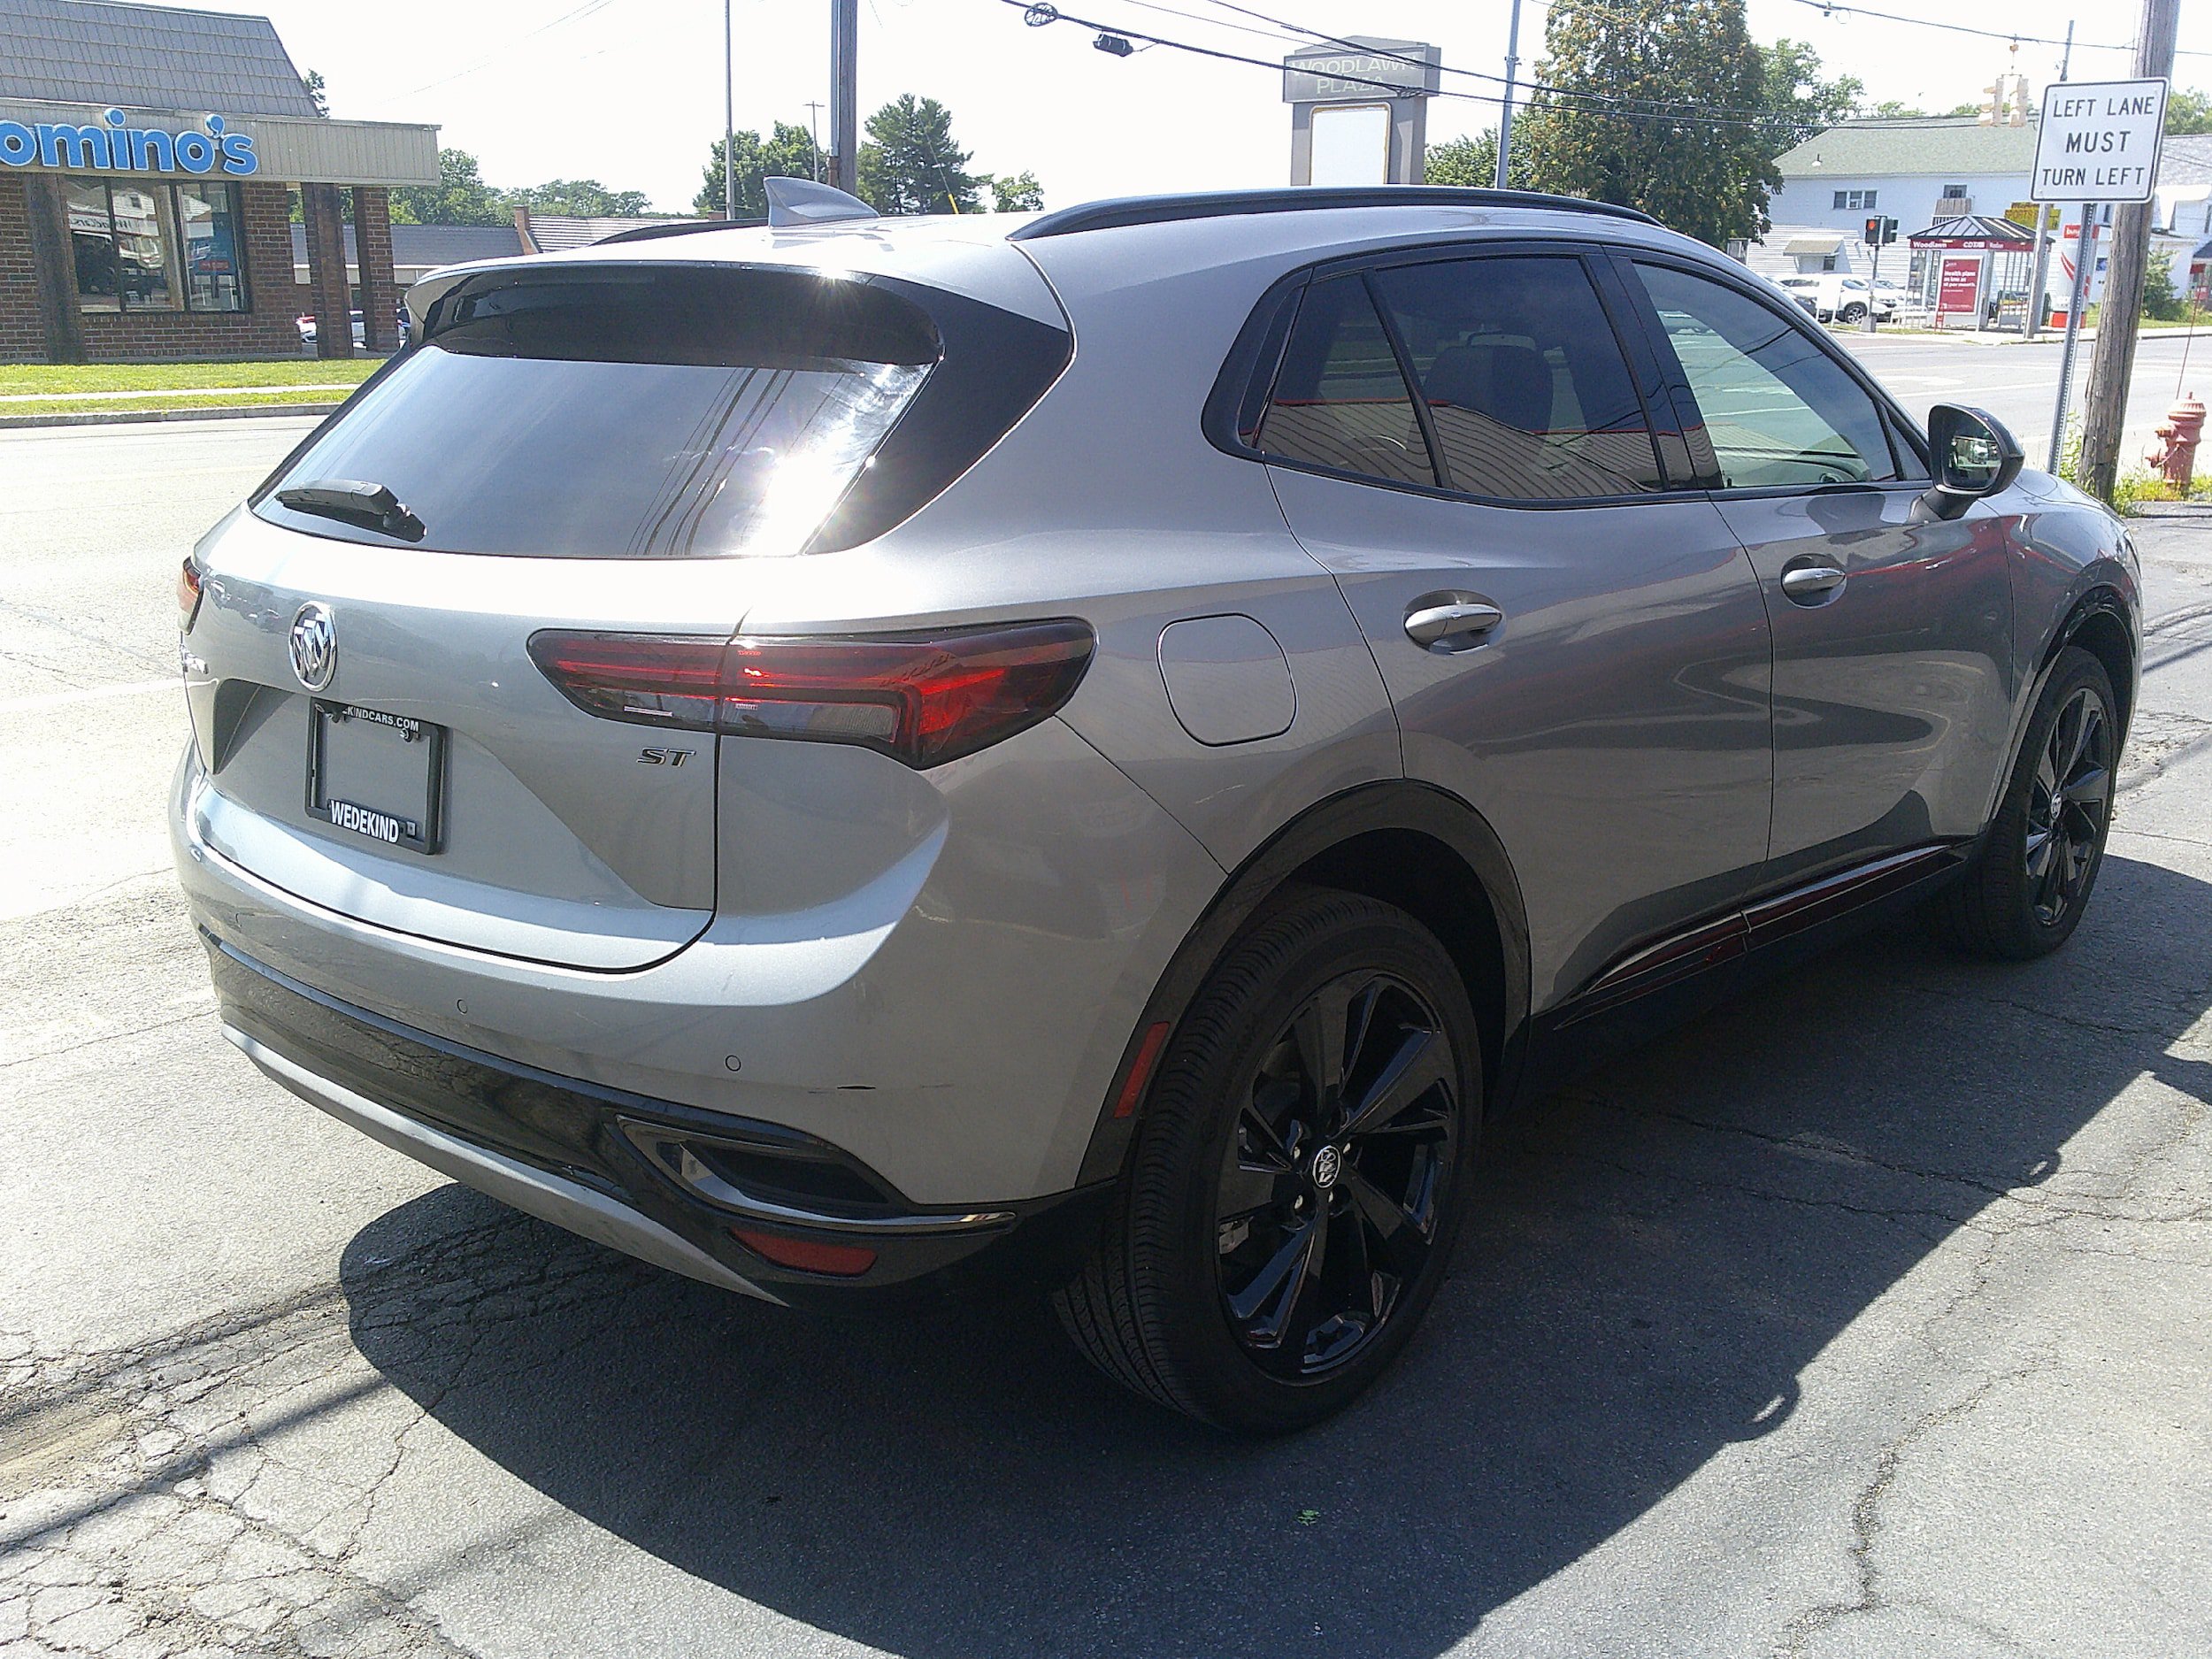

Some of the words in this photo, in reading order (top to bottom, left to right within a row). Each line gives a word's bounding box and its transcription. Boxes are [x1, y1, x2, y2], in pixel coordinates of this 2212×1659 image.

[1317, 76, 1386, 95] PLAZA
[2053, 98, 2097, 118] LEFT
[2107, 96, 2154, 116] LANE
[2065, 131, 2131, 153] MUST
[2042, 168, 2086, 186] TURN
[2095, 167, 2145, 186] LEFT
[636, 746, 696, 767] ST
[330, 799, 399, 843] WEDEKIND
